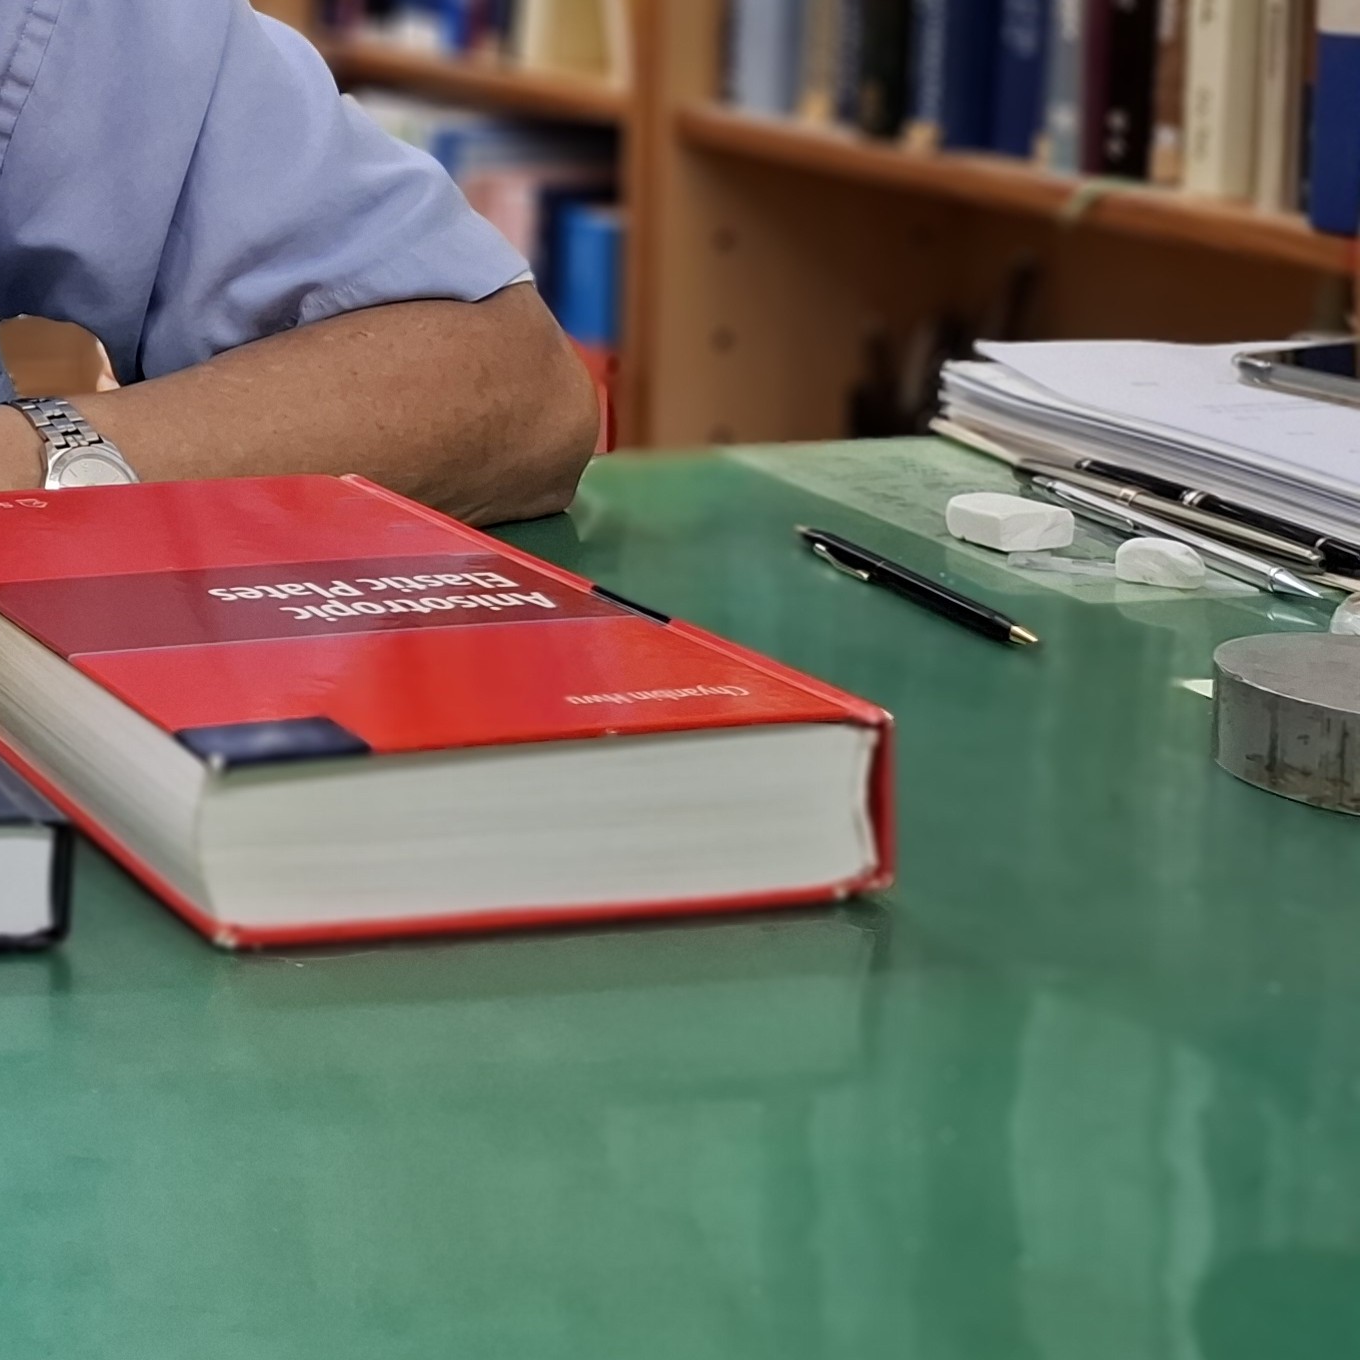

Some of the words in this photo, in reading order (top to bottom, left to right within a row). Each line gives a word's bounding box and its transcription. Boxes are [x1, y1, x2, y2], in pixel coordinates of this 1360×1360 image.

[206, 577, 356, 609] Plates
[355, 570, 519, 605] Elastic
[278, 589, 559, 626] Anisotropic
[563, 693, 633, 705] Hwu
[627, 683, 750, 702] Chyanbin
